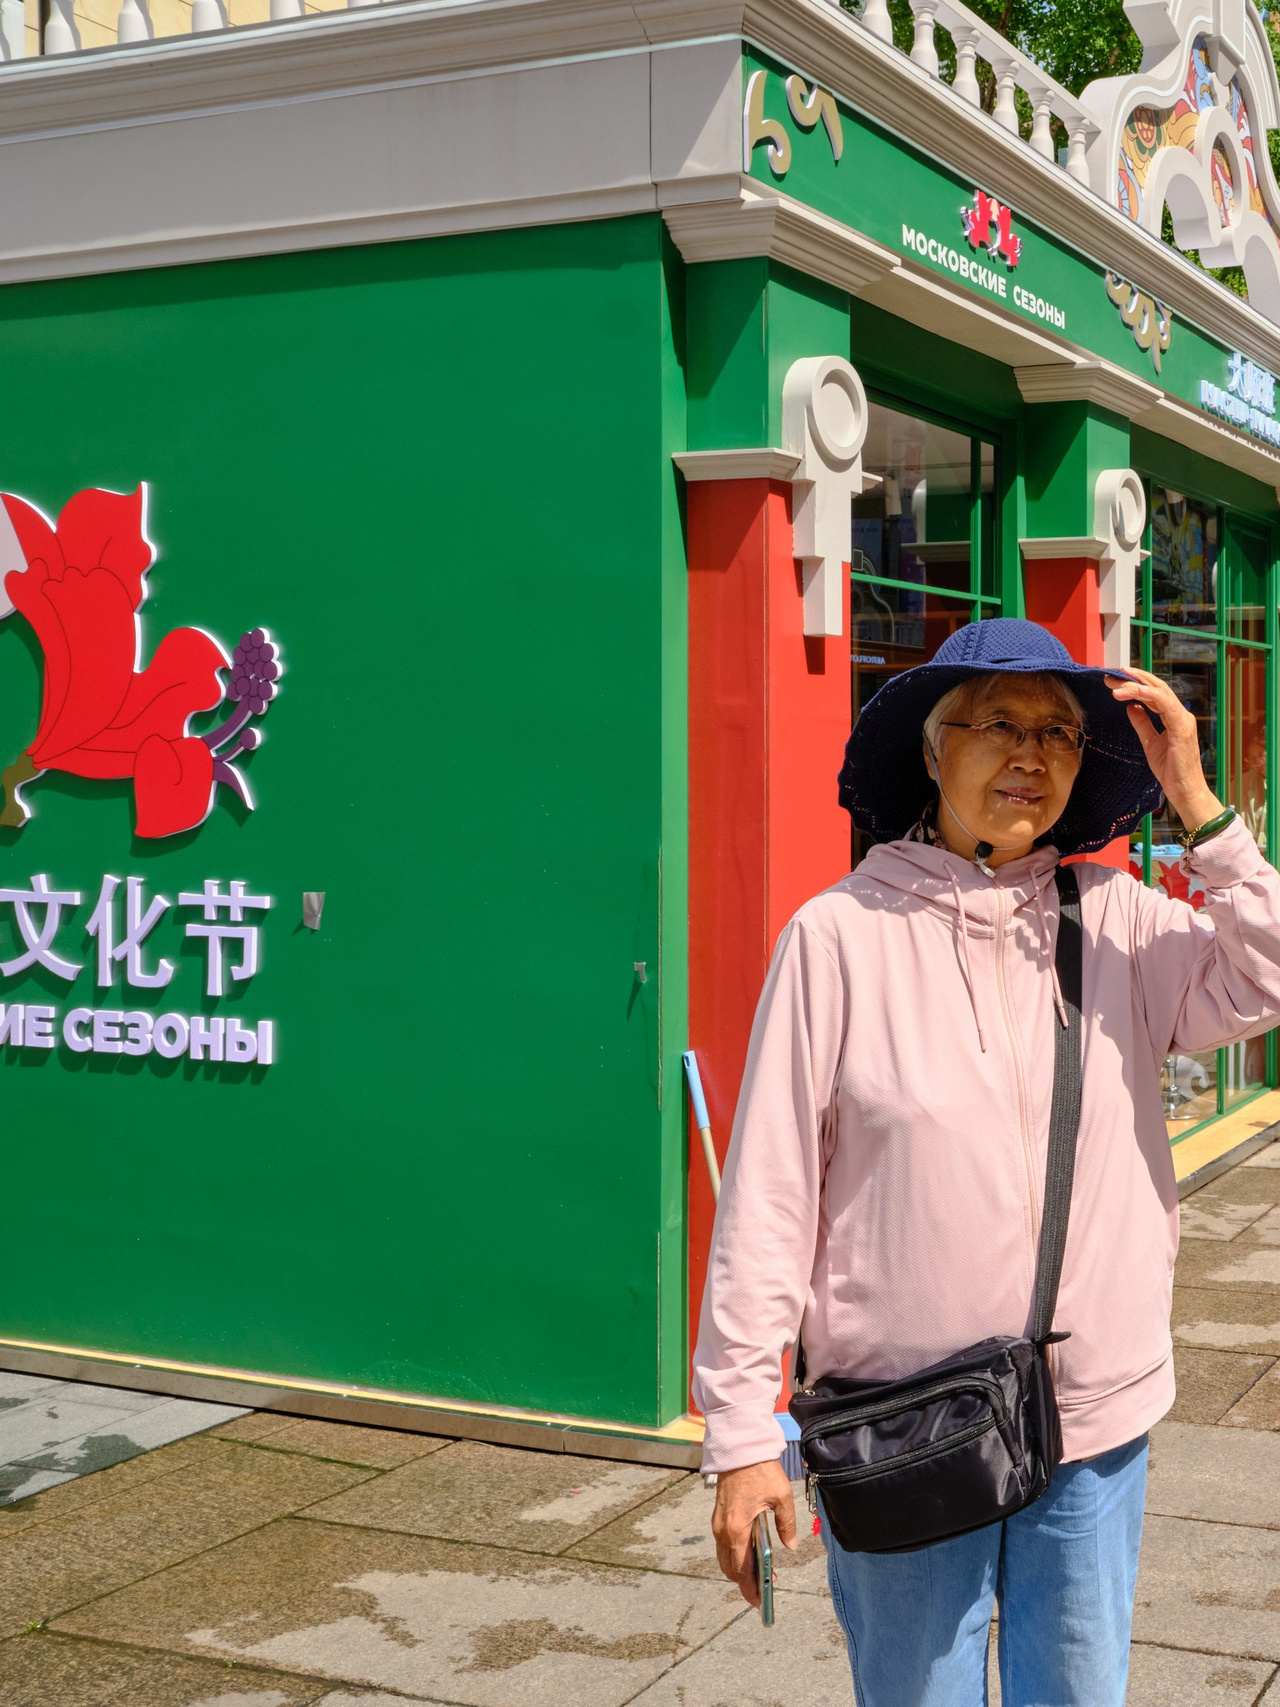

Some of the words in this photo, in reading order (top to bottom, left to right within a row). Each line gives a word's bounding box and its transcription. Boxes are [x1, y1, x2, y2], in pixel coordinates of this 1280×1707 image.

[901, 223, 1007, 298] МОСКОВСКИЕ
[1012, 285, 1066, 329] СЕЗОНЫ
[0, 873, 271, 997] 文化节
[62, 1007, 273, 1065] СЕЗОНЫ
